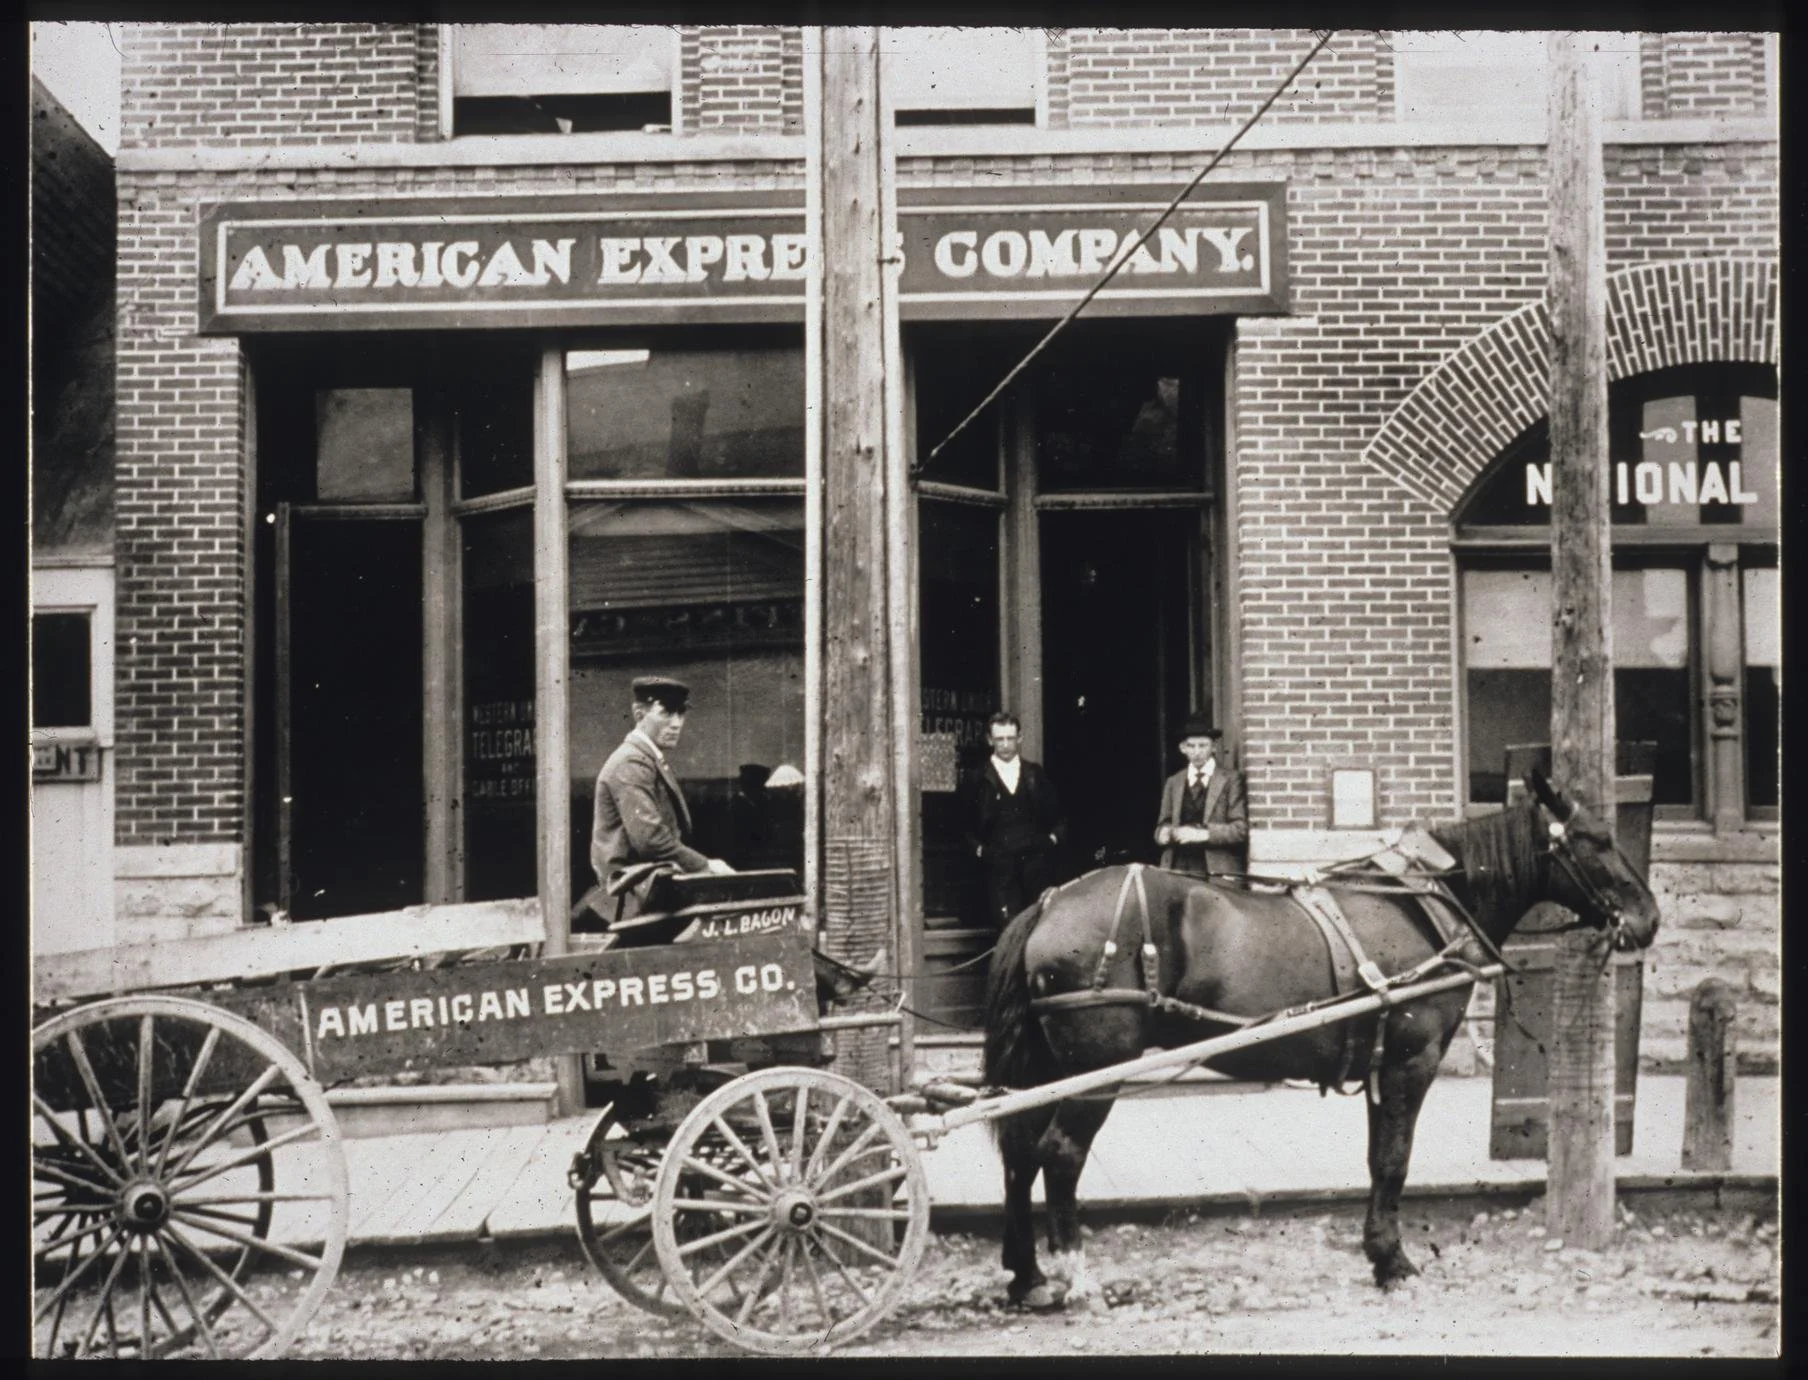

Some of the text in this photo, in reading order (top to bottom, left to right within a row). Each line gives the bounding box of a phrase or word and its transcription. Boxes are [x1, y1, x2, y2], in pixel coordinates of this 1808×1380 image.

[228, 227, 1254, 290] AMERICAN EXPRE COMPANY.
[1682, 419, 1742, 444] THE
[1526, 461, 1759, 505] NIONAL
[472, 728, 537, 759] TELEGRA
[702, 920, 719, 938] J.
[317, 962, 797, 1039] AMERICAN EXPRESS CO.
